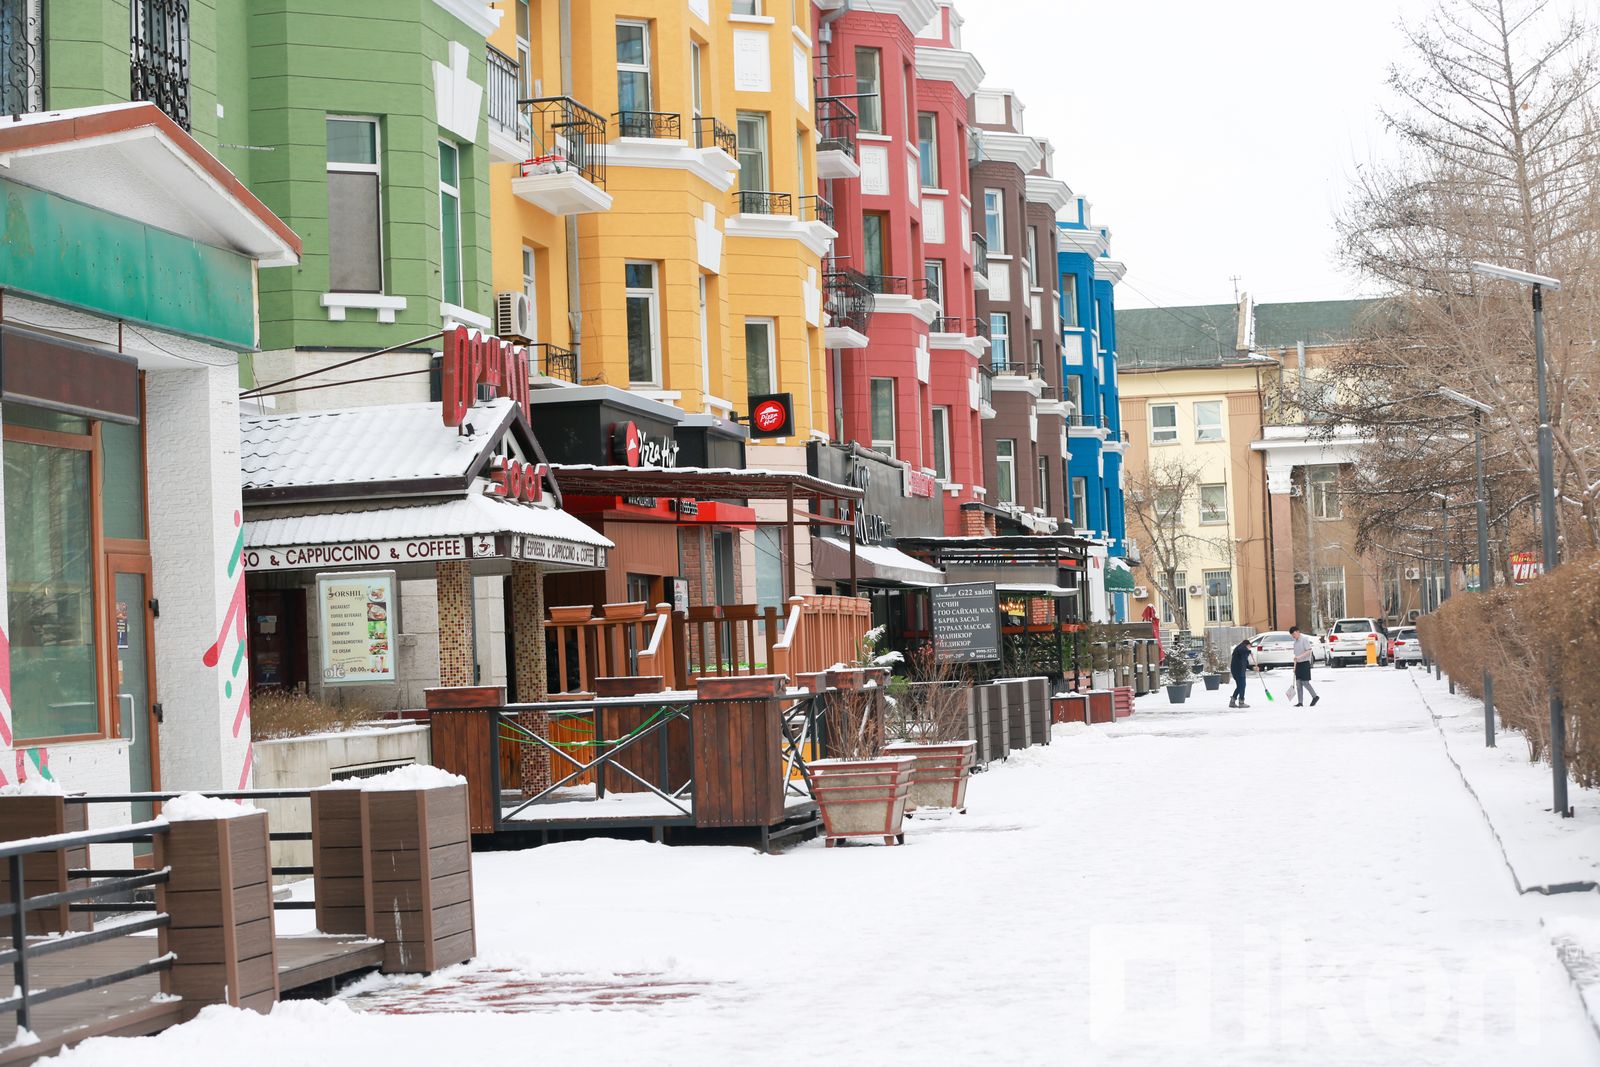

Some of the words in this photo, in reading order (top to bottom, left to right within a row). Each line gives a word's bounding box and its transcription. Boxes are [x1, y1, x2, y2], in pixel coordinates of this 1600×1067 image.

[760, 413, 778, 422] Pizza
[763, 418, 777, 426] Hut
[270, 554, 280, 566] &
[286, 544, 381, 566] CAPPUCCINO
[390, 547, 400, 560] &
[406, 540, 461, 558] COFFEE
[974, 588, 993, 596] salon
